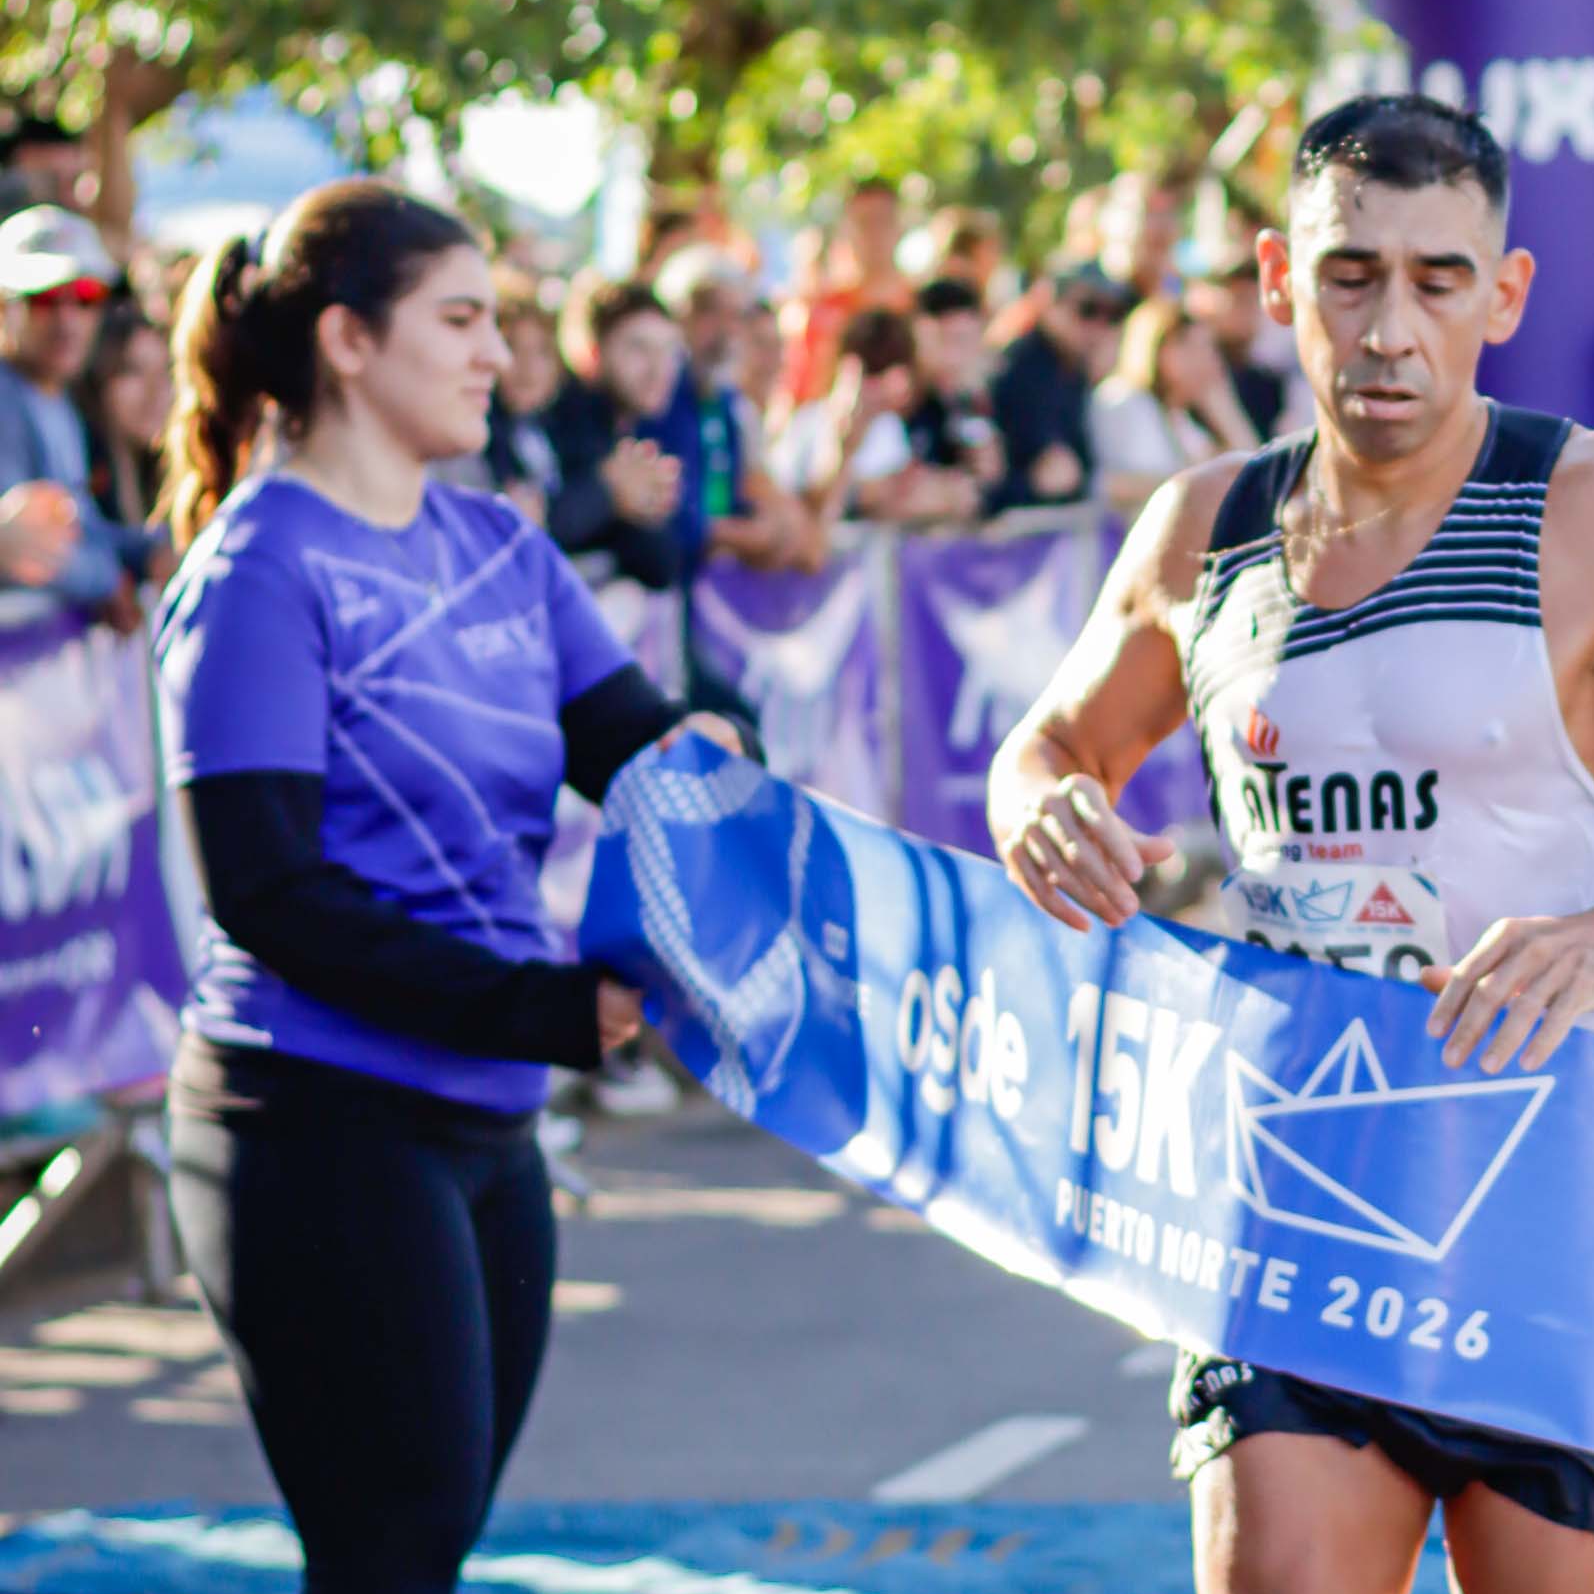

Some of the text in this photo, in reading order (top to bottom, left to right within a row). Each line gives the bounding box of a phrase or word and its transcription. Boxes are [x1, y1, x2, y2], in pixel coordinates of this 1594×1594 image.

[898, 965, 1028, 1119] osde
[1067, 981, 1222, 1198] 15K
[1055, 1177, 1491, 1361] PUERTO NORTE 2026
